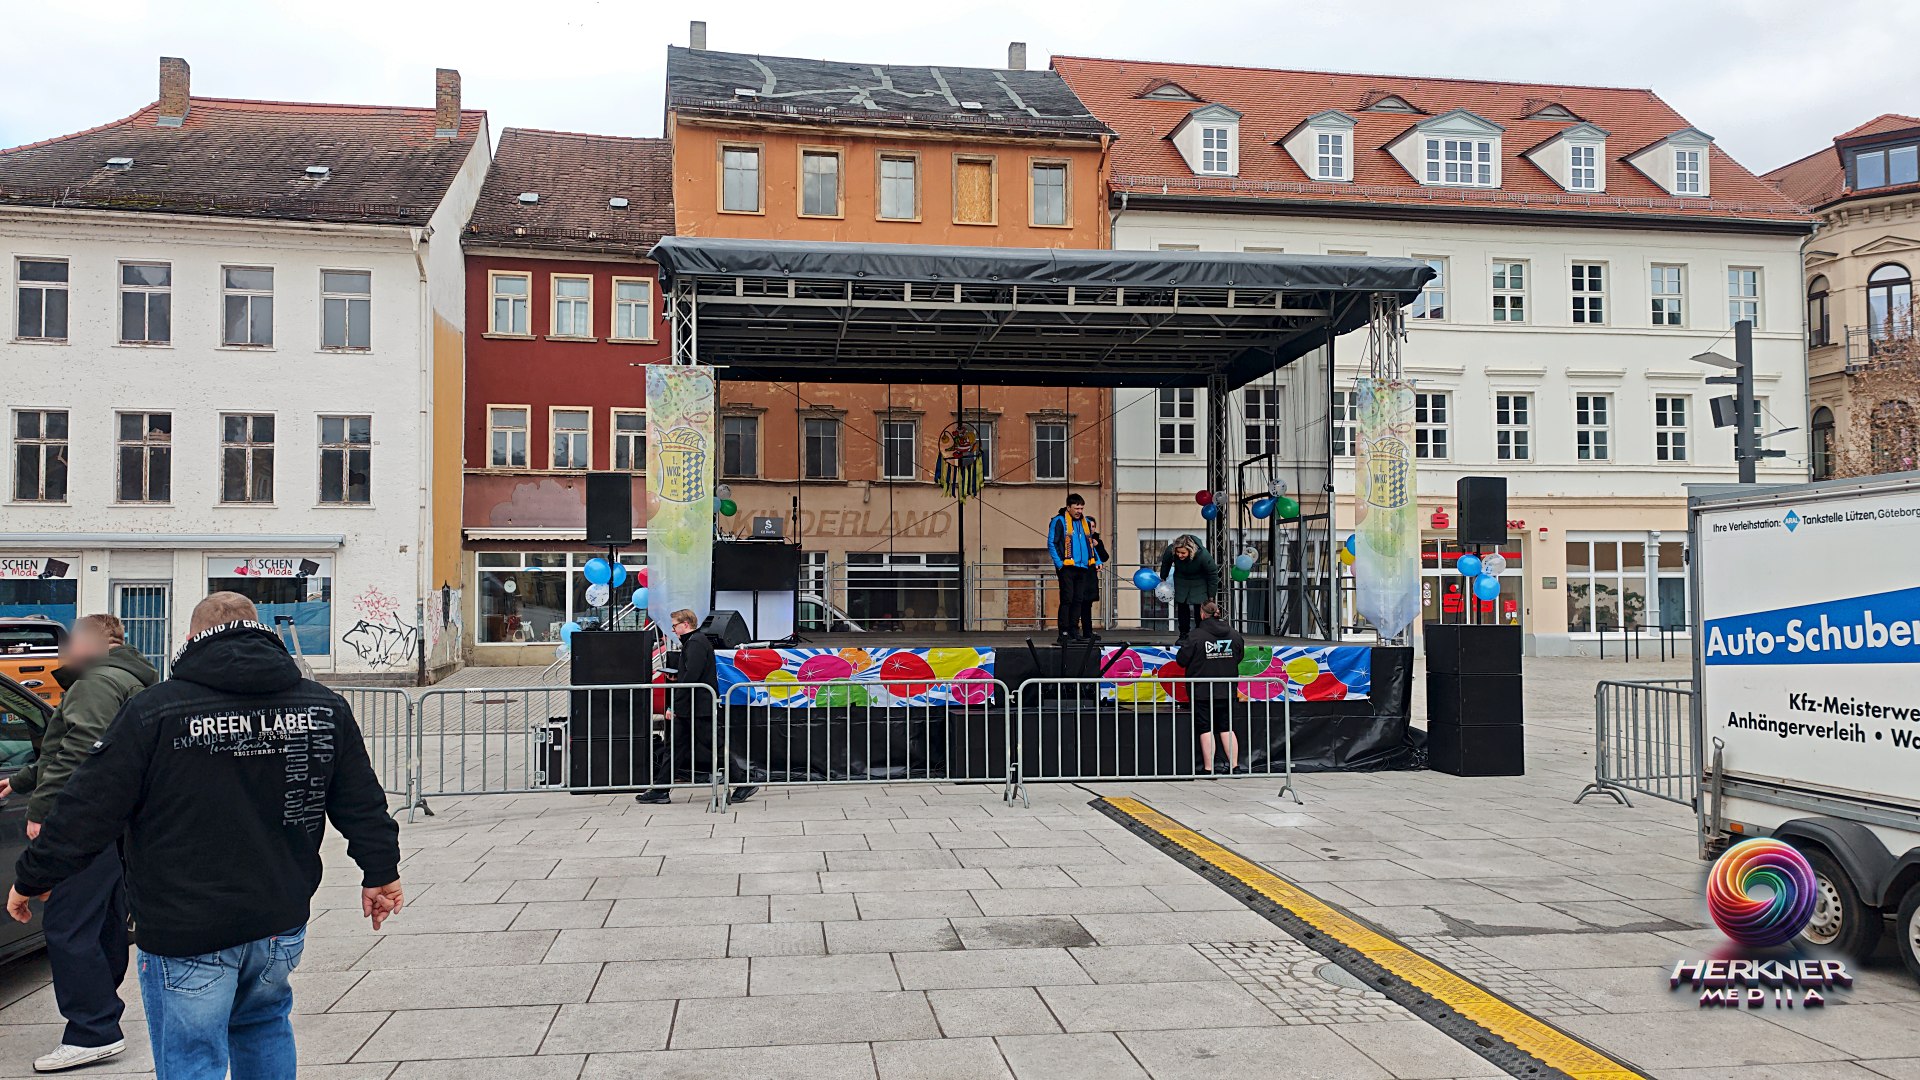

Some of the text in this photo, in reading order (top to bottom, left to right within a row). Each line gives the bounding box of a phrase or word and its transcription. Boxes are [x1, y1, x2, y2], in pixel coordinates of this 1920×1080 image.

[732, 510, 952, 538] KNDERLAND
[1713, 523, 1727, 533] Ihre
[1729, 518, 1782, 532] Verleihstation:
[1802, 512, 1843, 525] Tankstelle
[1845, 510, 1877, 521] Lützen,
[12, 567, 38, 577] Mode
[268, 566, 293, 576] Mode
[193, 623, 226, 643] DAVID
[1789, 693, 1920, 722] Kfz-Meisterwe
[189, 713, 318, 737] GREEN LABEL
[1728, 711, 1866, 743] Anhängerverleih
[233, 749, 276, 757] REGISTERED
